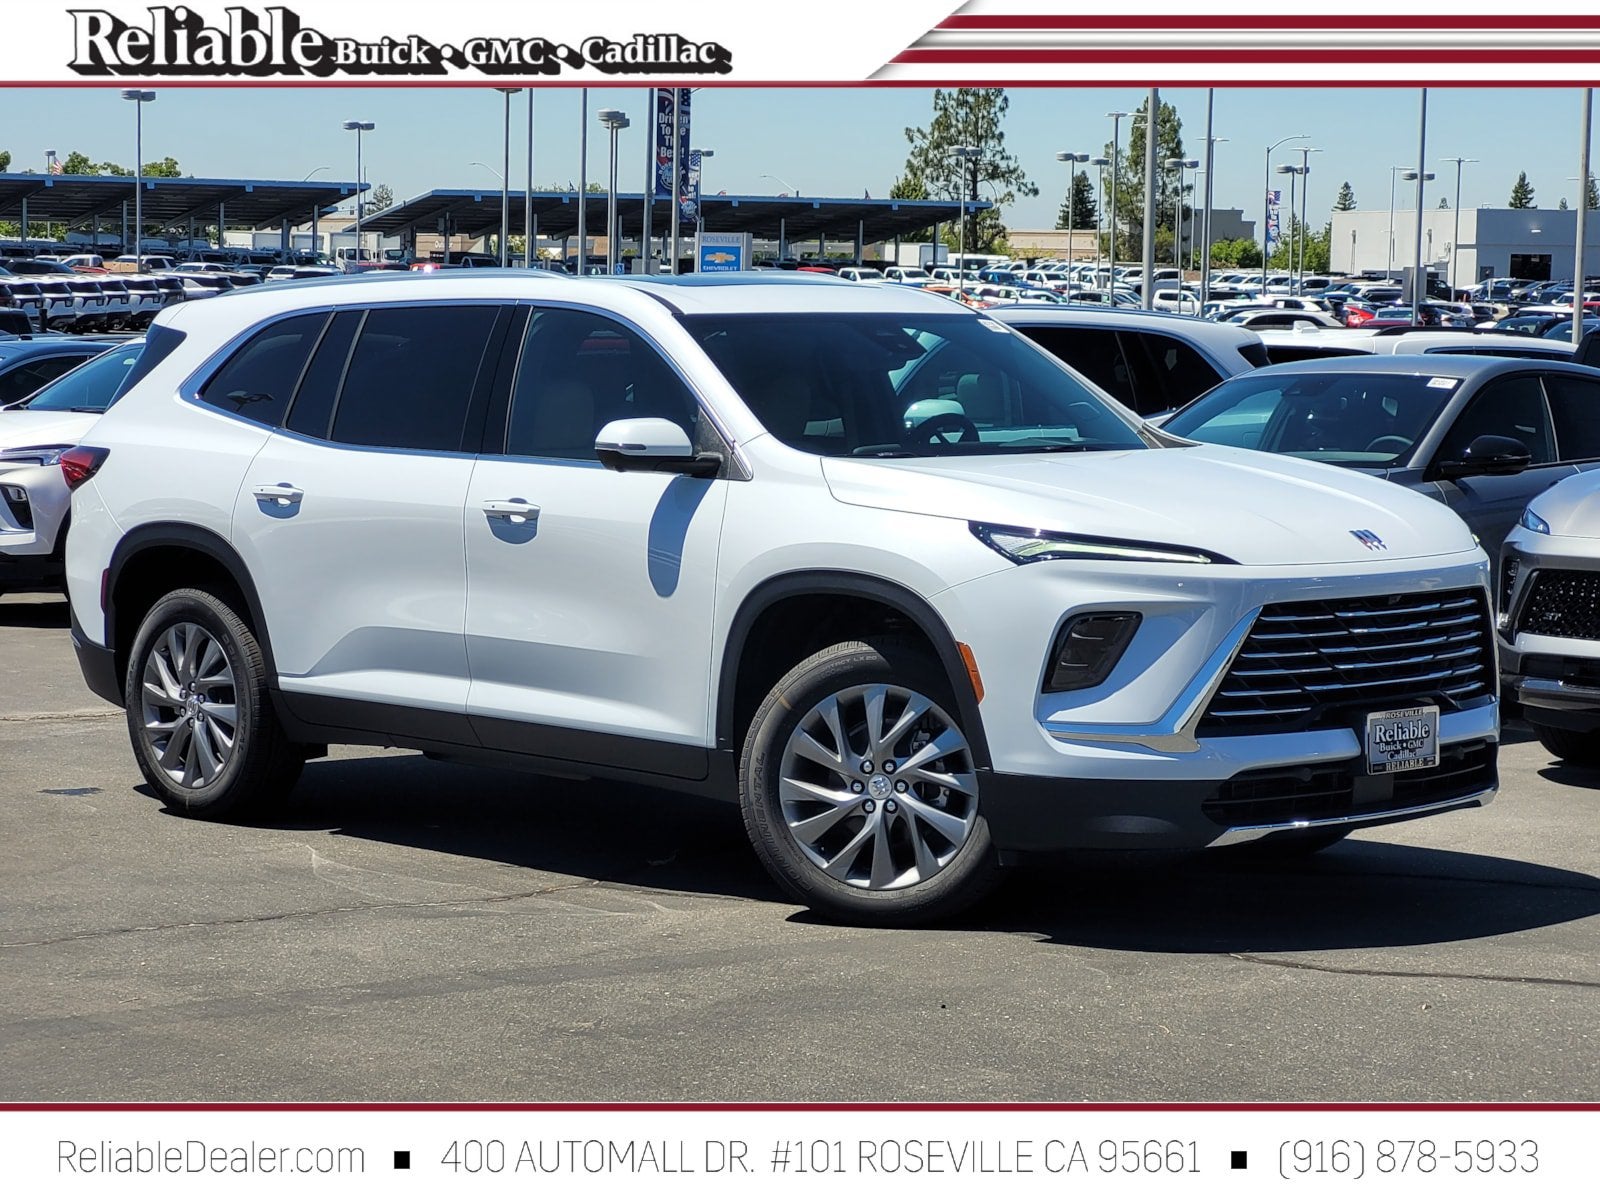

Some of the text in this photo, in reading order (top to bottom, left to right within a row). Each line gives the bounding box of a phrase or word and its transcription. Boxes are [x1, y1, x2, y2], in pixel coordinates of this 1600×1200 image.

[660, 124, 671, 135] To
[702, 234, 741, 243] ROSEVILLE
[1385, 708, 1424, 719] ROSEVILLE
[1375, 720, 1430, 743] Reliable
[1380, 739, 1424, 752] Buick GMC
[1387, 749, 1417, 761] Cadillac
[1385, 758, 1424, 771] RELIABLE
